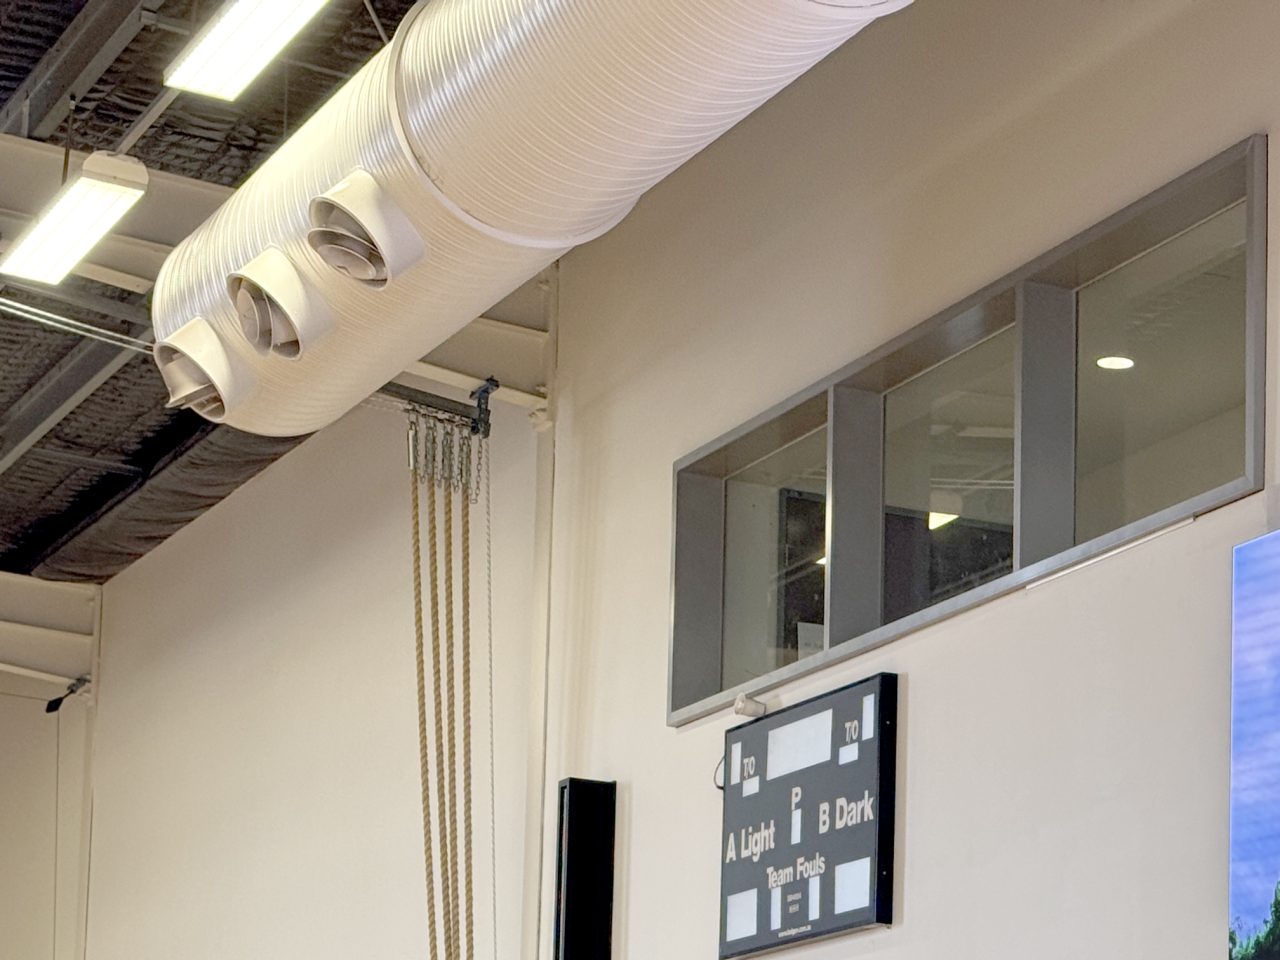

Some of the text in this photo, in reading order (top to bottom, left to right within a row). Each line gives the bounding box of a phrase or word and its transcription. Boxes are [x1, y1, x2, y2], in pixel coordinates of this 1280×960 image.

[791, 786, 802, 811] P
[819, 789, 874, 834] B Dark
[726, 819, 776, 863] A Light
[766, 851, 826, 889] Team Fouls
